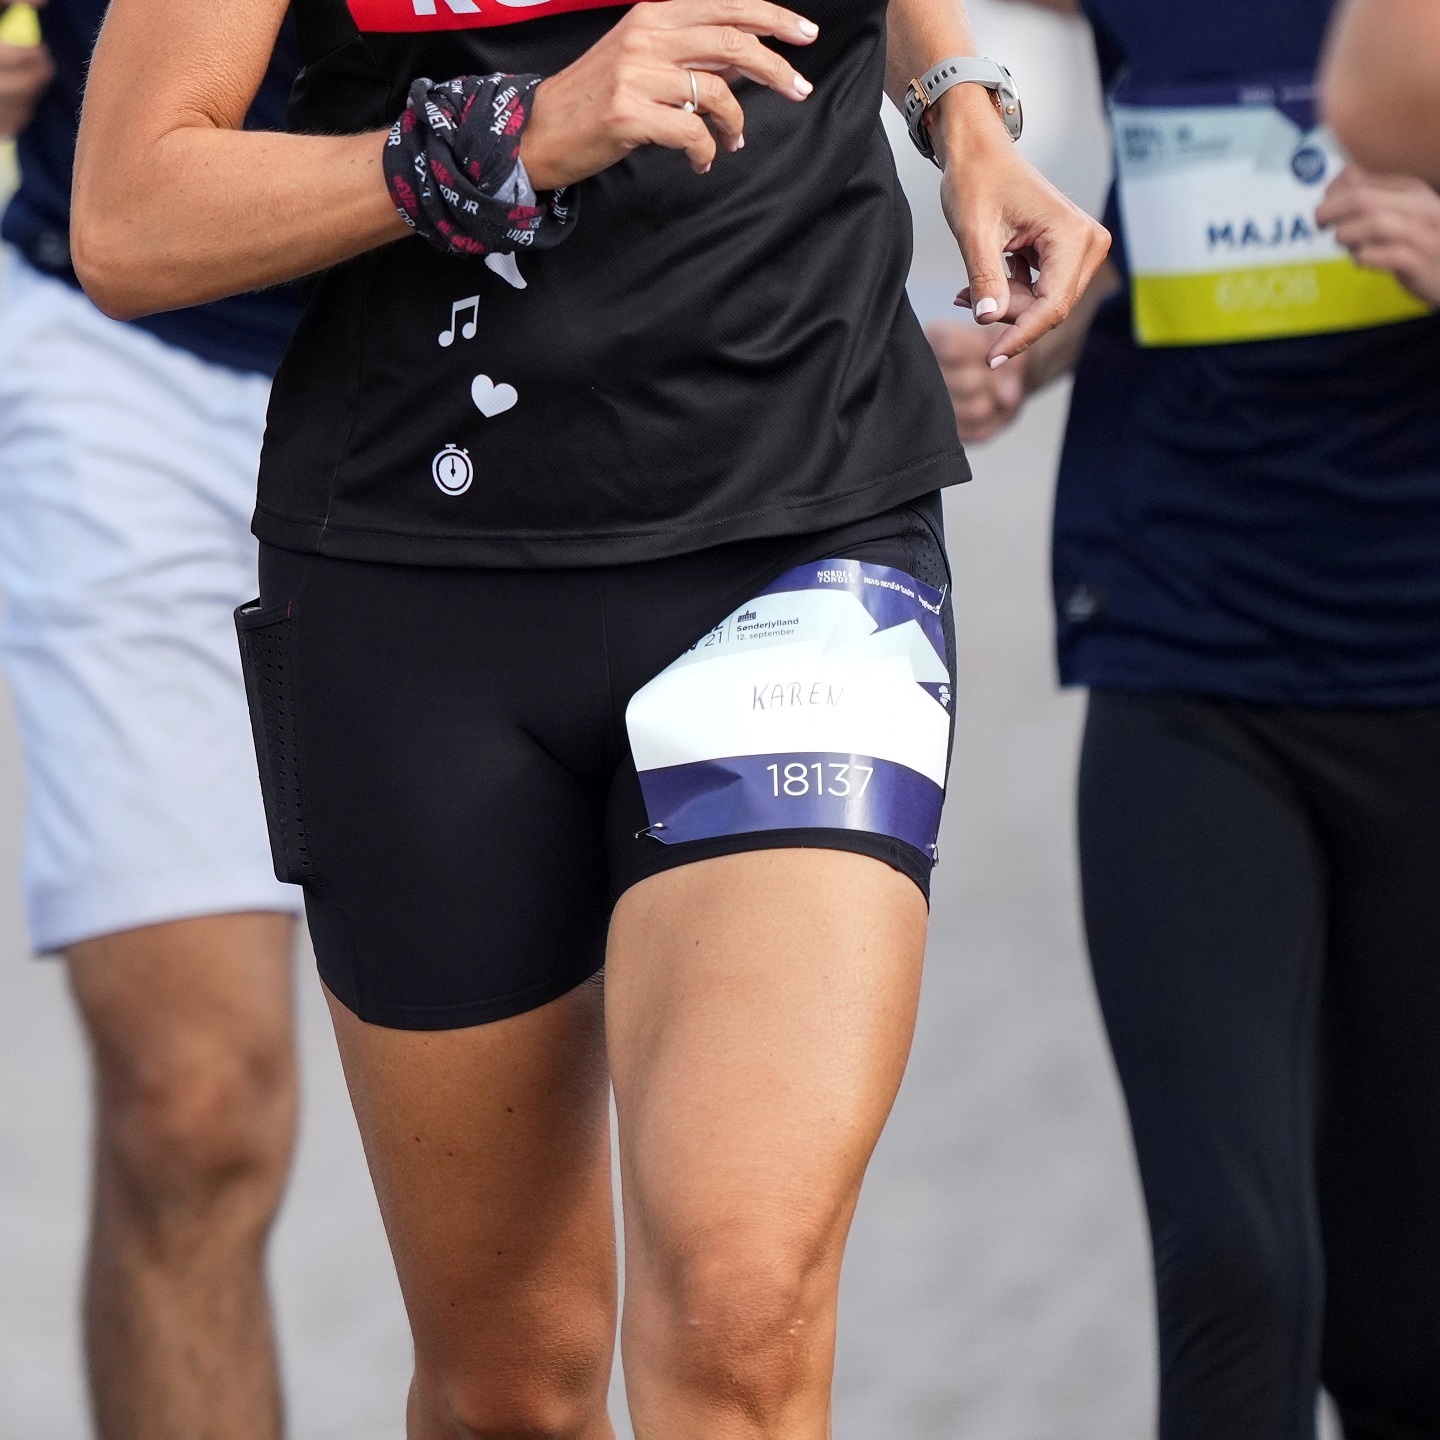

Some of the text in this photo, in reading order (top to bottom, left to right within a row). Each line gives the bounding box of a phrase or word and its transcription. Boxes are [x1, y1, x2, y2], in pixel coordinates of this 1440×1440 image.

[736, 618, 799, 633] Sønderjylland
[749, 629, 795, 641] september
[753, 681, 844, 711] KAREN
[766, 762, 874, 798] 18137
